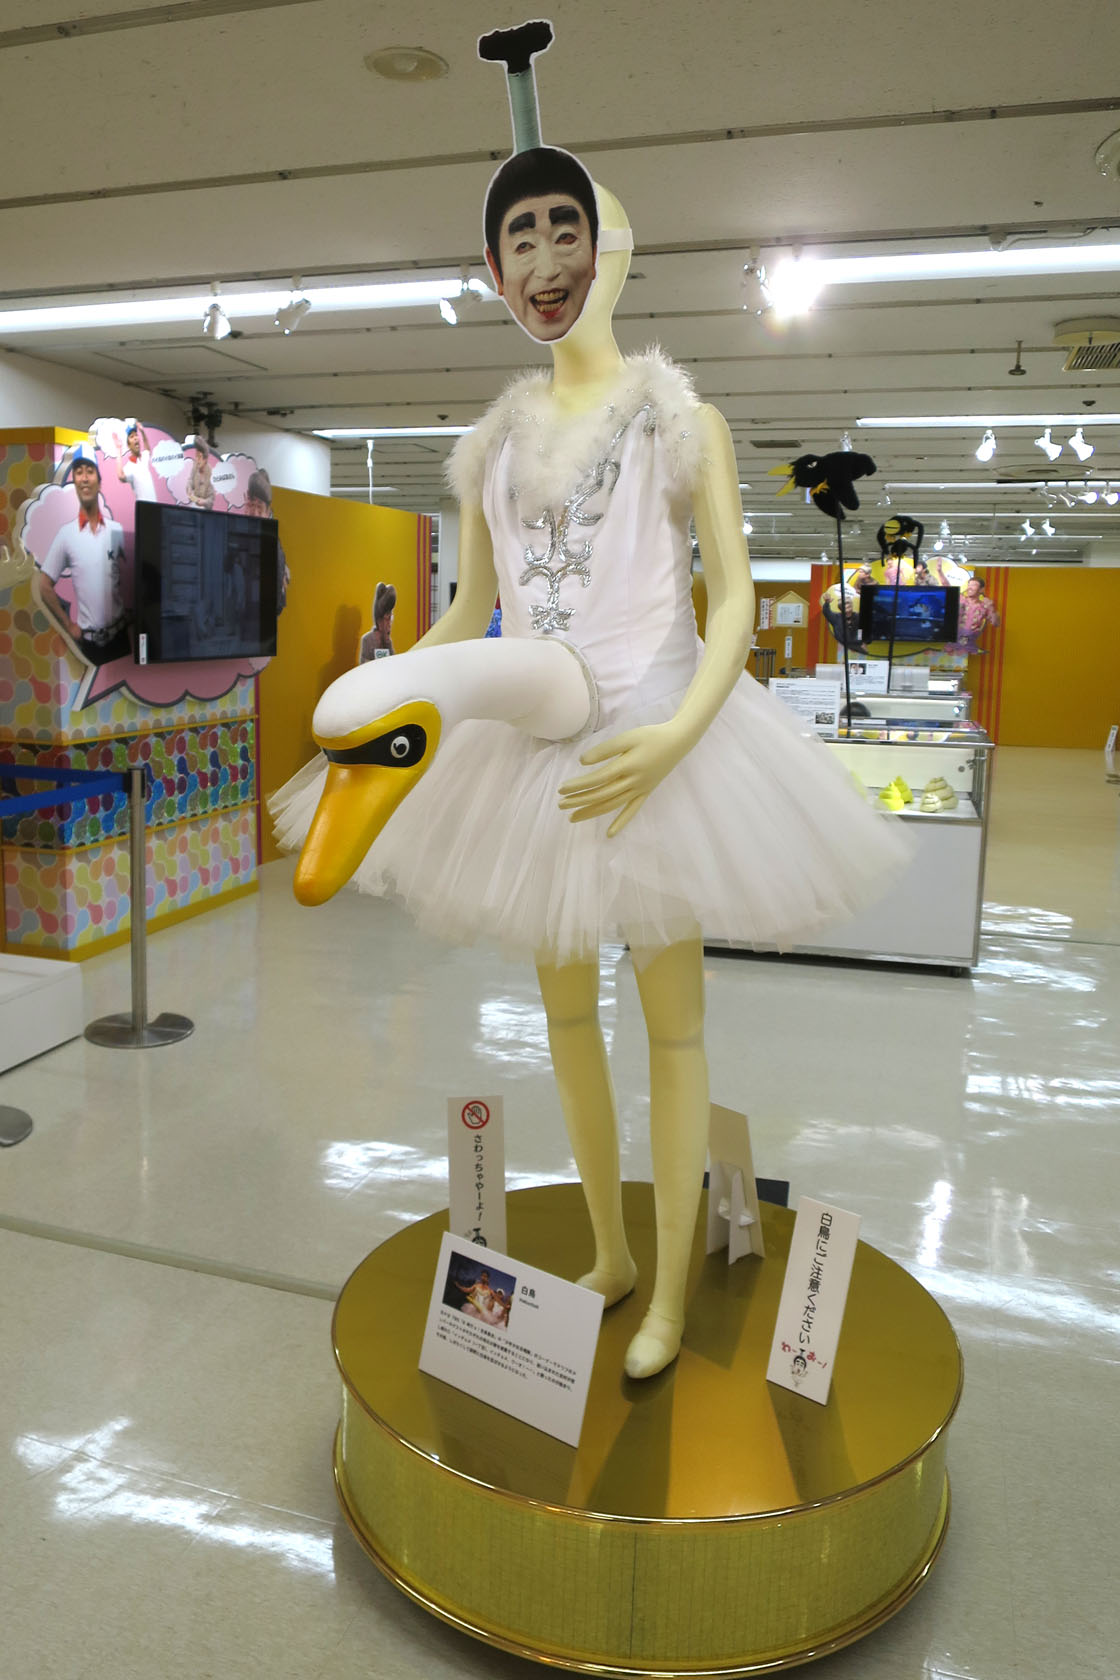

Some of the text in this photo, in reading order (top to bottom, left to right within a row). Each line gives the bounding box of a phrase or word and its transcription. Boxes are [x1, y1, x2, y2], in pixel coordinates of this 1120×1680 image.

[521, 1285, 536, 1299] 白鳥
[799, 1212, 833, 1345] 白鳥にご注意ください
